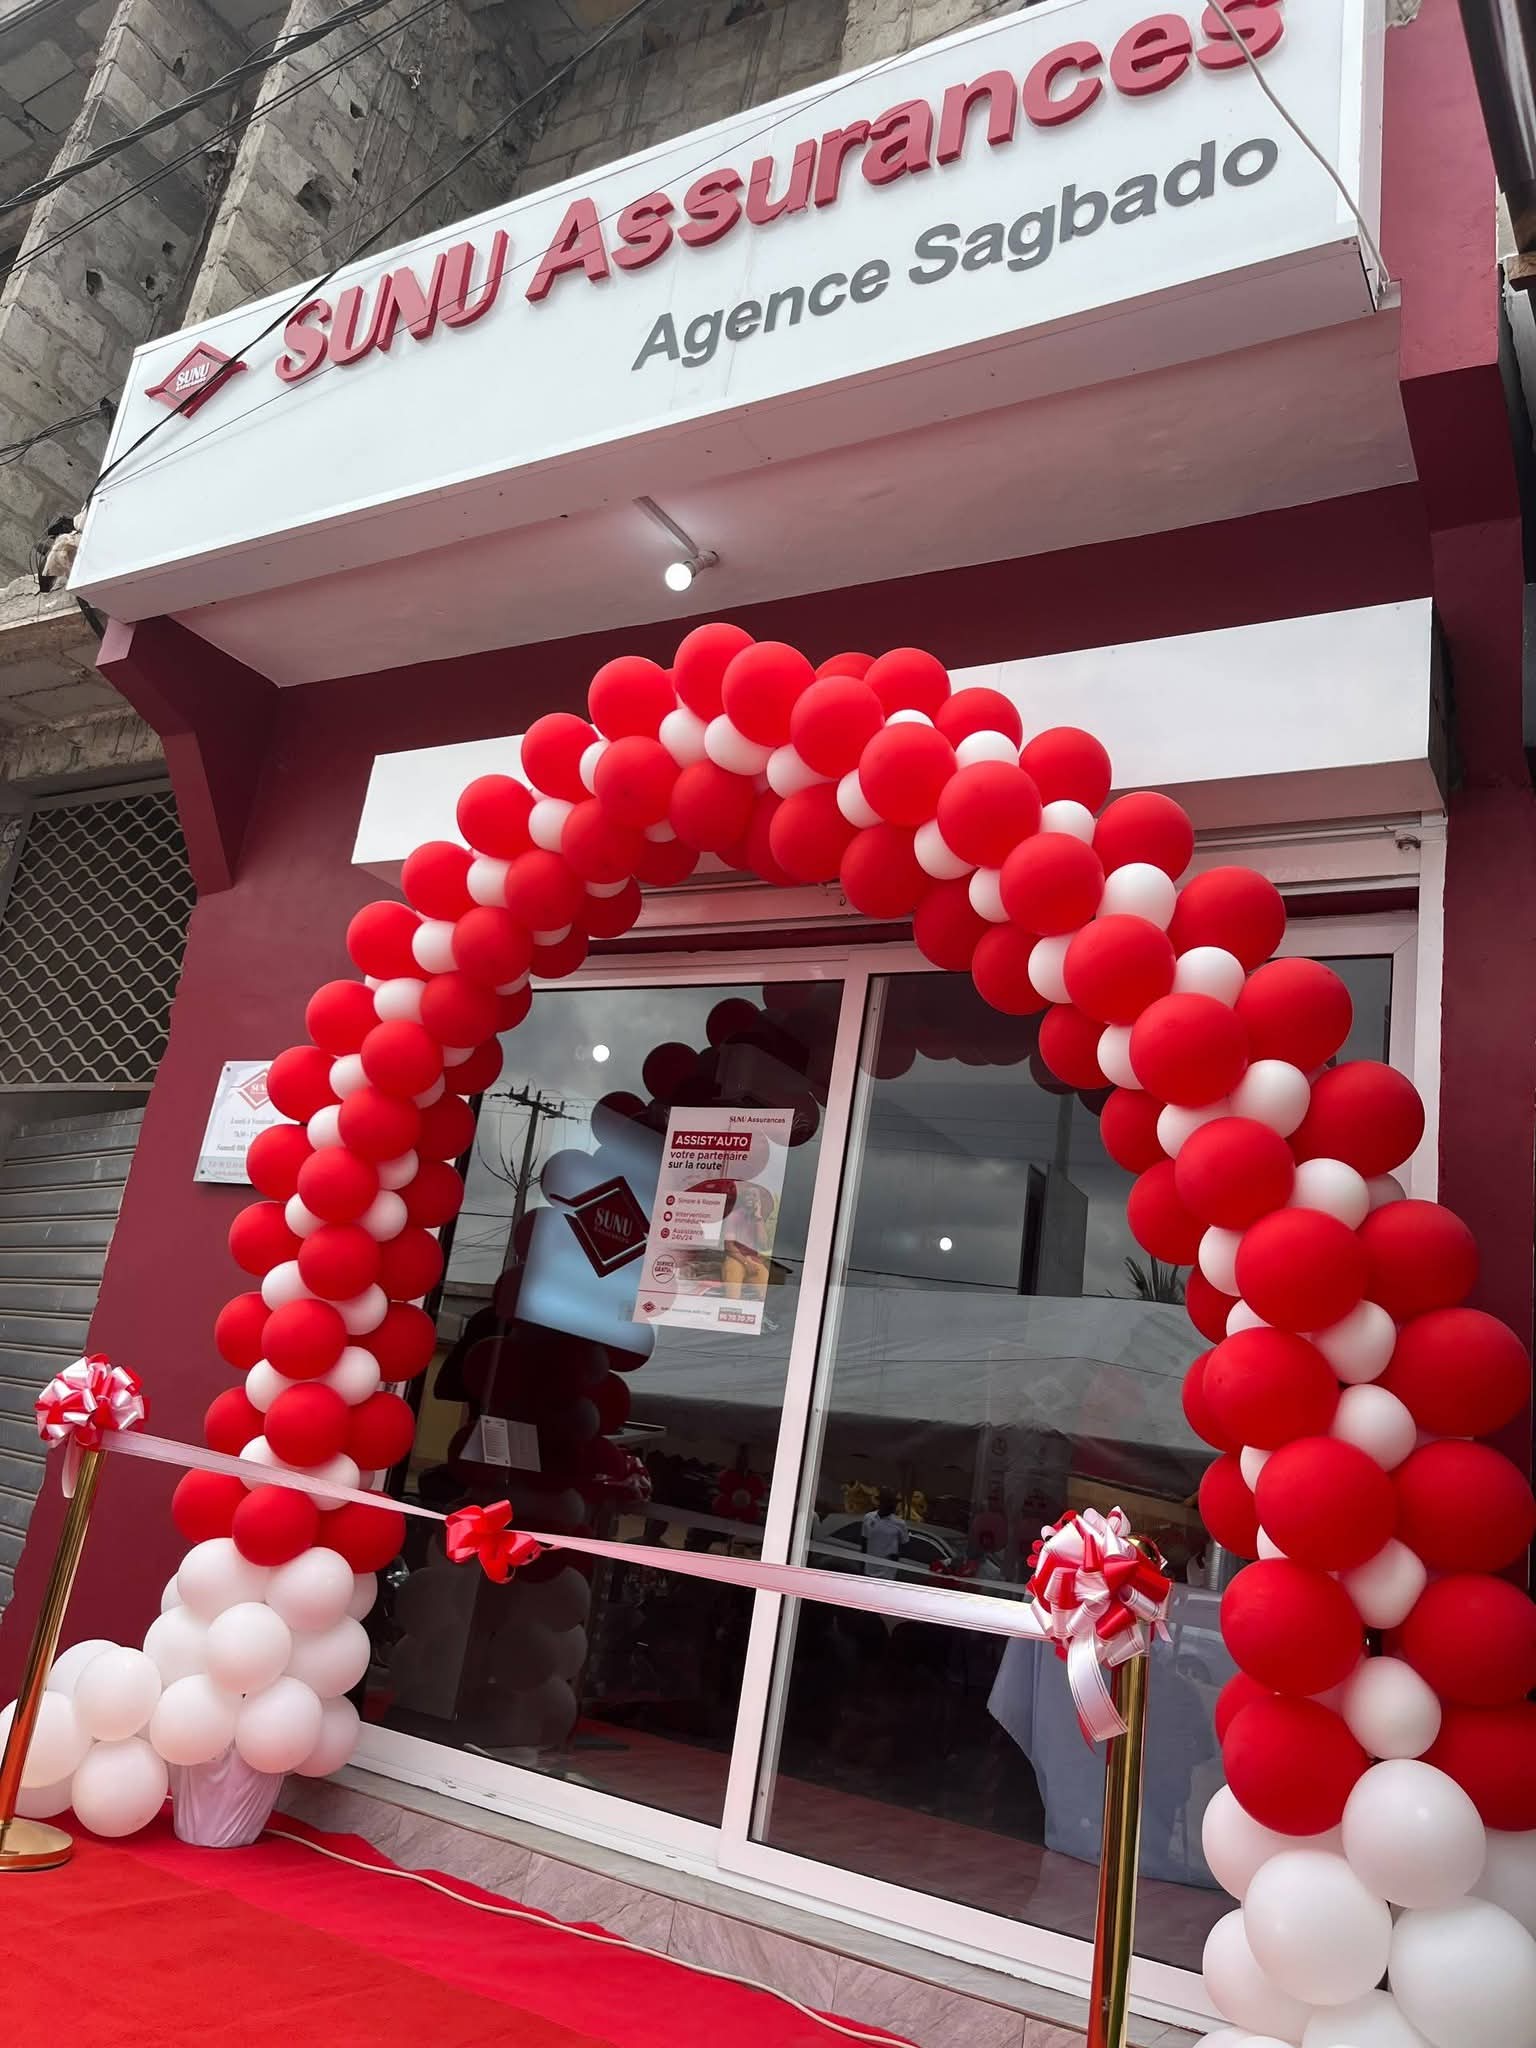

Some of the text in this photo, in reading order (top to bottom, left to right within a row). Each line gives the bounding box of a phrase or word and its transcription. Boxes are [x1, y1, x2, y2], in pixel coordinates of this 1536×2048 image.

[275, 0, 1285, 385] SUNU Assurances
[632, 137, 1279, 371] Agence Sagbado
[175, 362, 210, 387] SUNU
[729, 1115, 786, 1124] SUNU Assurances
[675, 1135, 749, 1147] ASSIST'AUTO
[667, 1160, 722, 1170] sur la route
[670, 1150, 749, 1162] votre partenaire
[594, 1207, 633, 1238] SUNU
